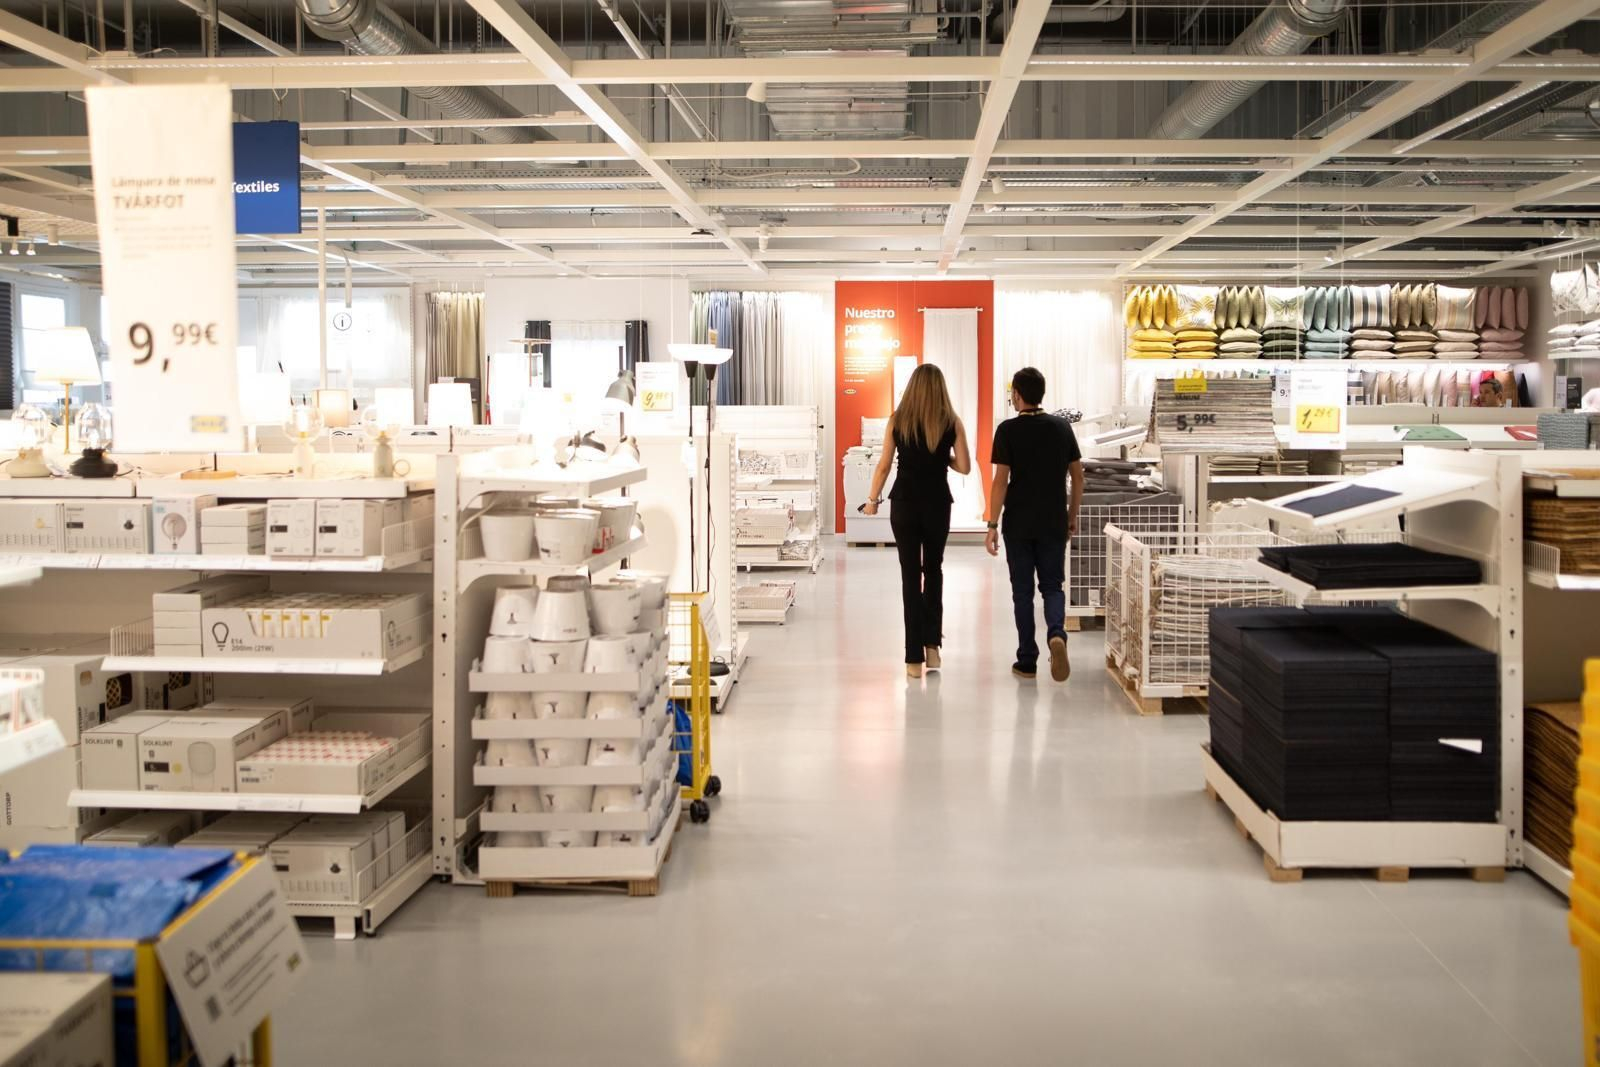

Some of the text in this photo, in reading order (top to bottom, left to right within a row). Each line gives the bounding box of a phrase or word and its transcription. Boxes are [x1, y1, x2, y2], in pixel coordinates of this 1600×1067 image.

[232, 180, 280, 194] Textiles
[845, 307, 896, 319] Nuestro
[143, 739, 174, 747] SOLKLINT
